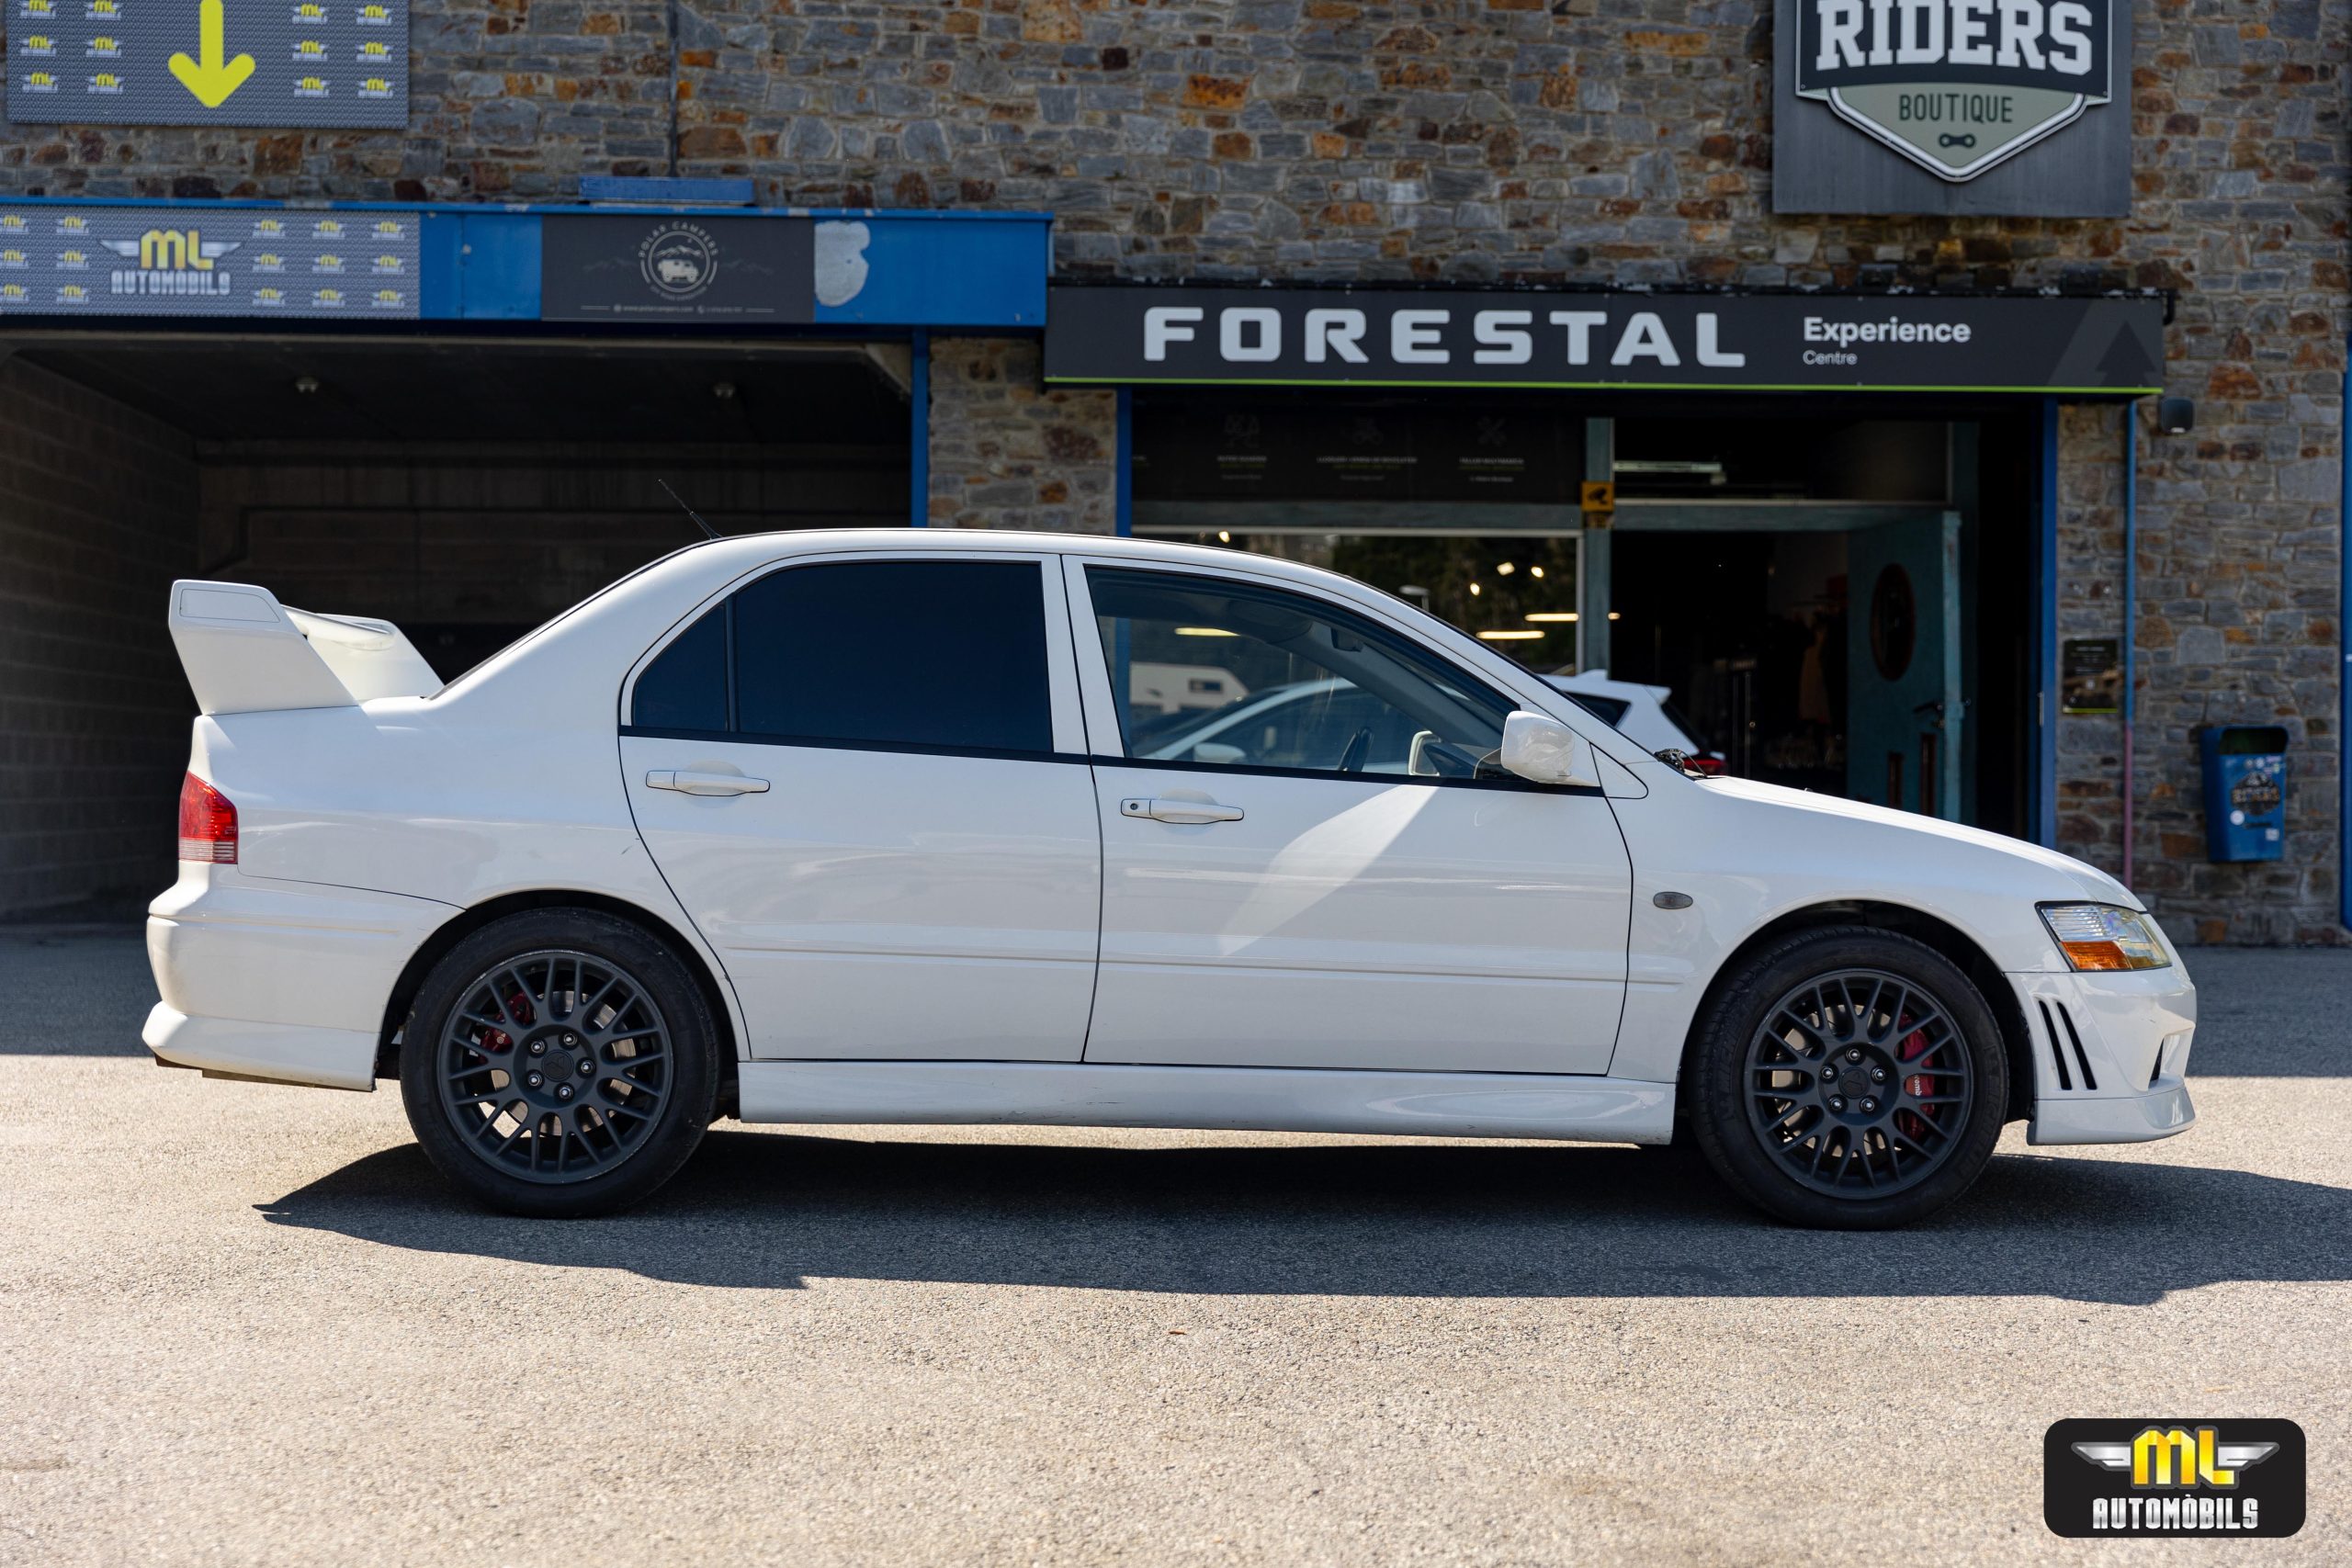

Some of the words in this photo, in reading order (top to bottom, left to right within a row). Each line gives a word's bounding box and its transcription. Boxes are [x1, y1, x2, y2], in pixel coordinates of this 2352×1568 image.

[1815, 0, 2093, 75] RIDERS
[1899, 94, 2013, 123] BOUTIQUE
[141, 230, 214, 270] ML
[638, 224, 667, 258] POLAR
[672, 220, 719, 256] CAMPERS
[1144, 306, 1746, 367] FORESTAL
[1804, 316, 1972, 347] Experience
[1803, 350, 1858, 366] Centre
